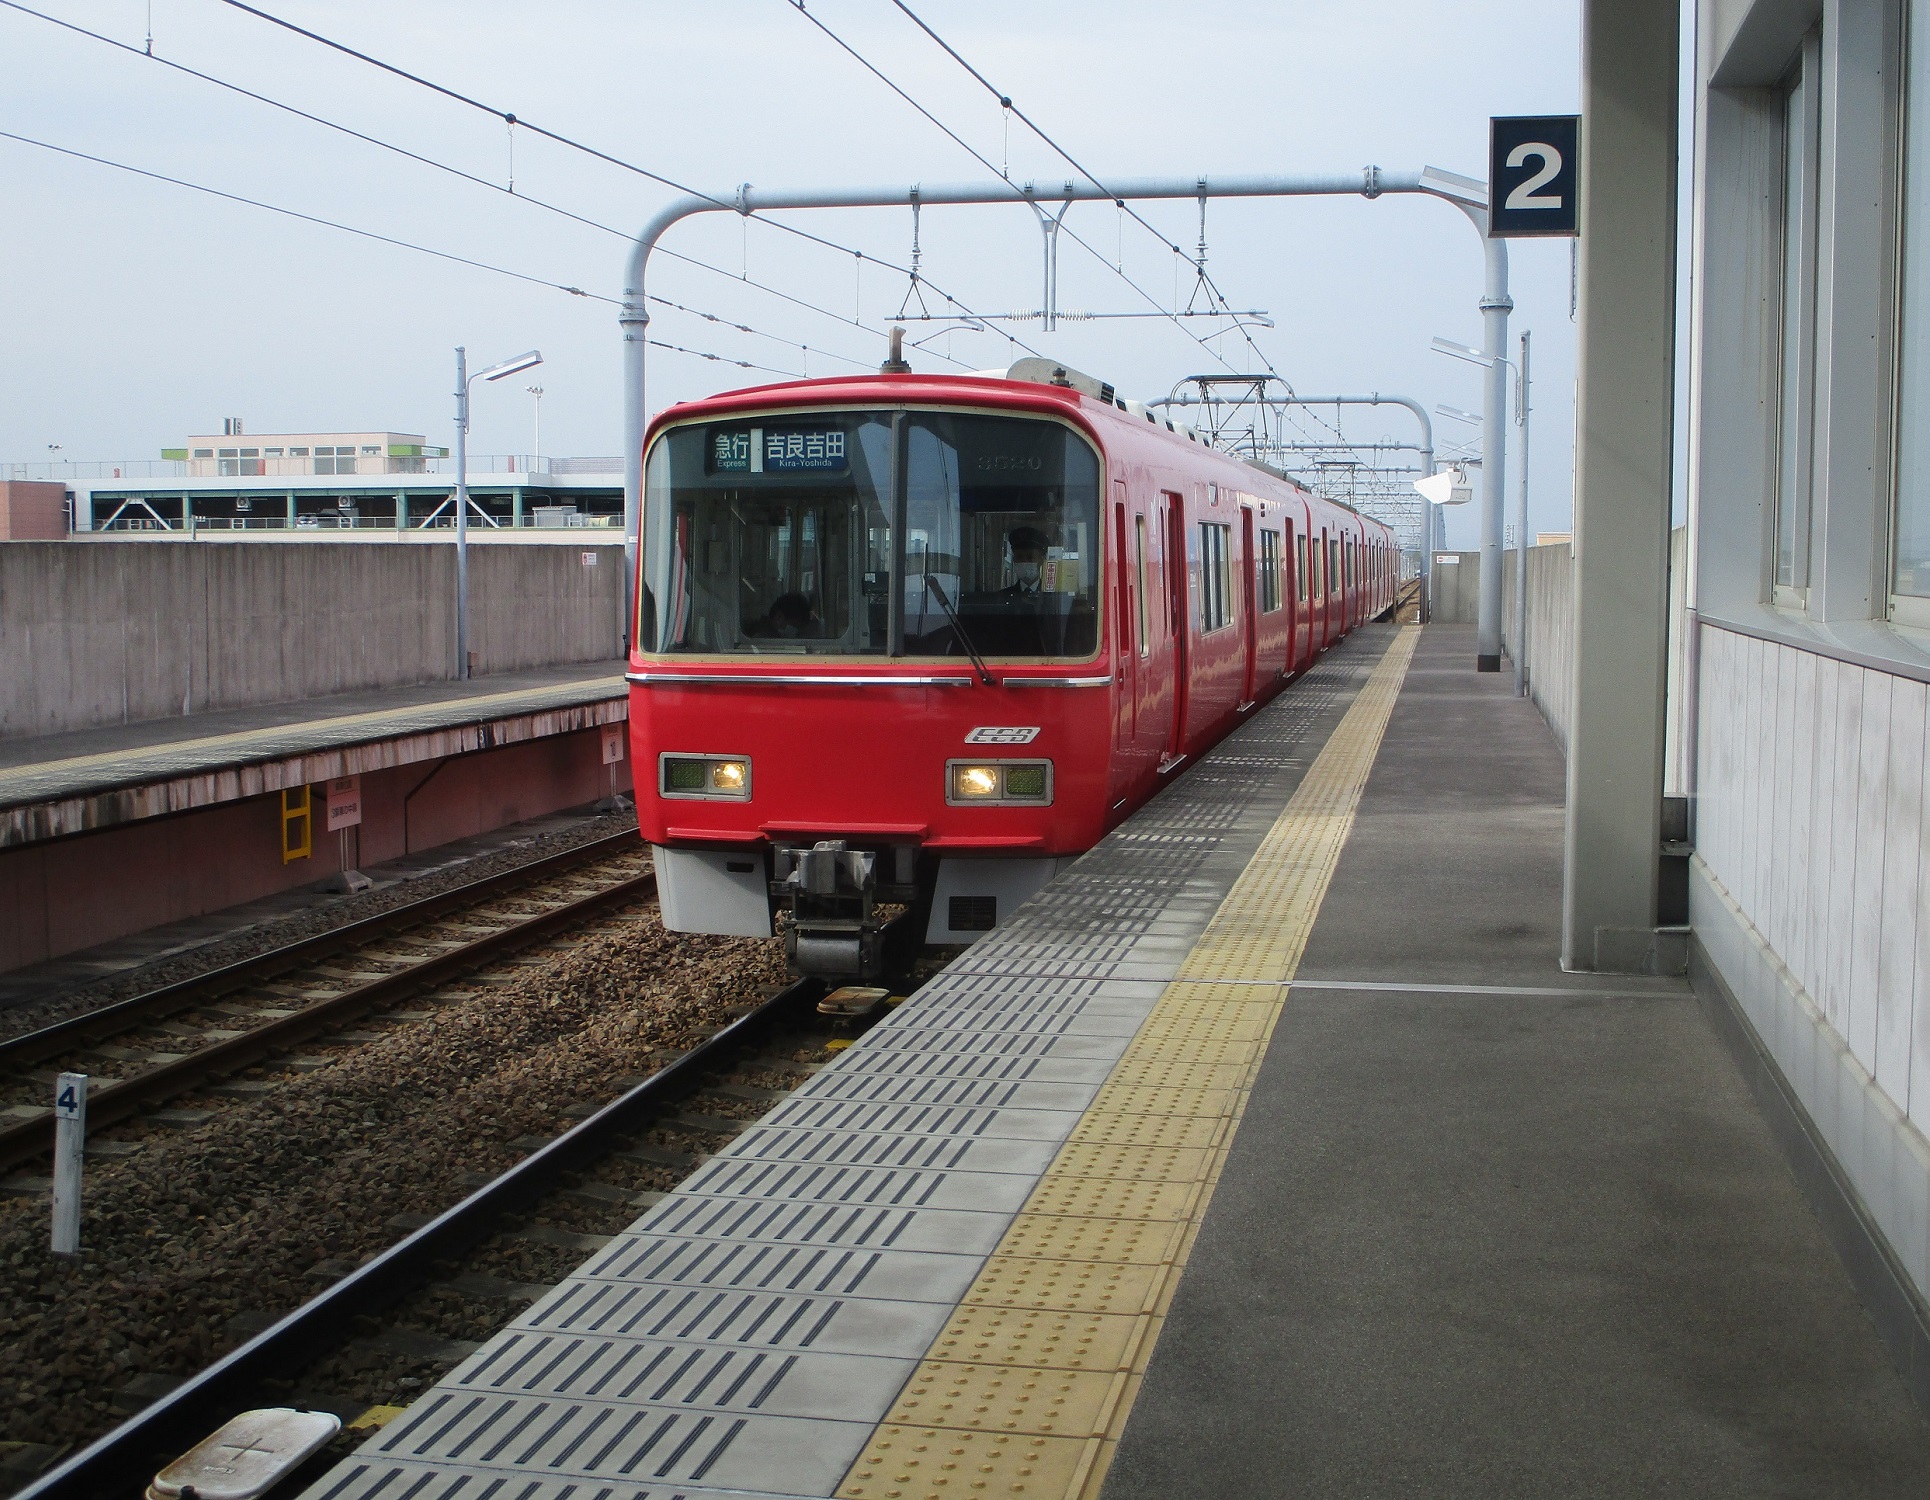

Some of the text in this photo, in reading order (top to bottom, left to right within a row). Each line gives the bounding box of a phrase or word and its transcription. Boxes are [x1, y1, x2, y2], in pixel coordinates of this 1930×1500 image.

[1504, 141, 1562, 210] 2
[715, 433, 749, 459] 急行
[766, 431, 845, 459] 吉良吉田
[717, 460, 747, 468] Express
[779, 459, 832, 467] Kira-Yoshida
[57, 1086, 78, 1113] 4
